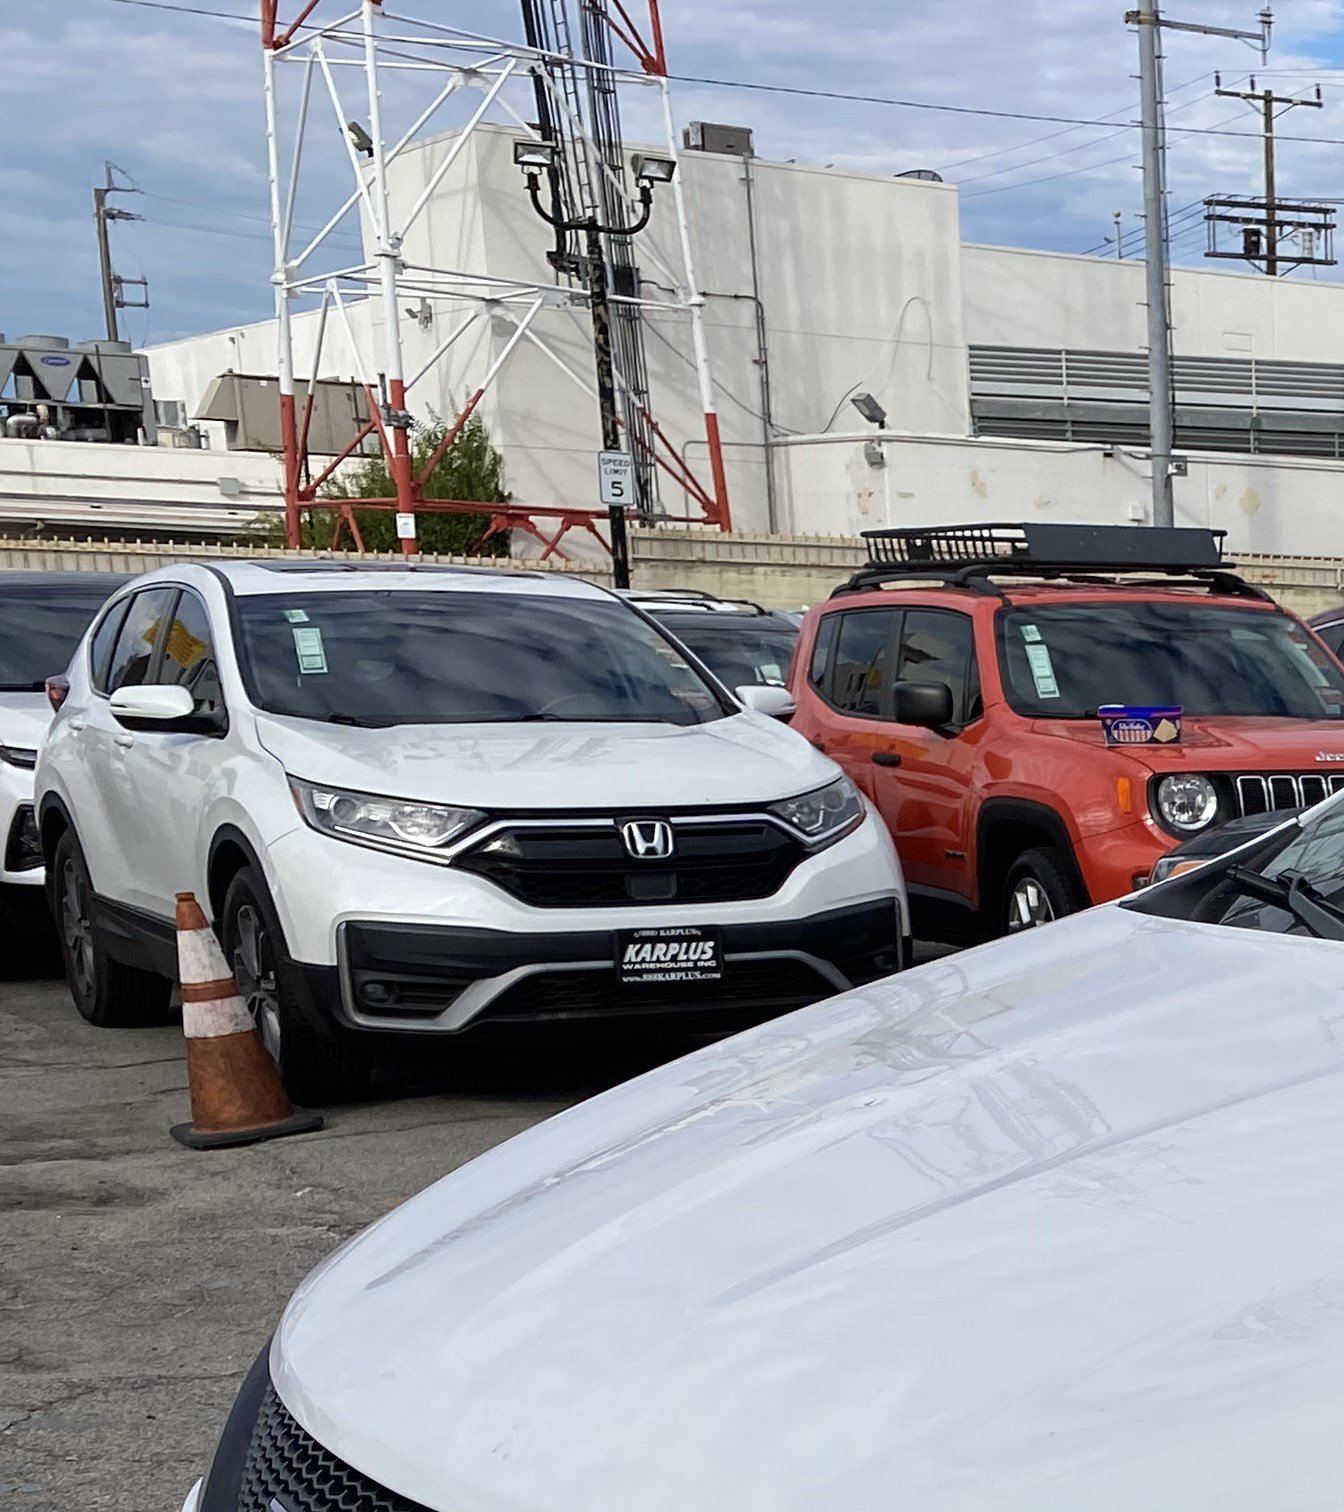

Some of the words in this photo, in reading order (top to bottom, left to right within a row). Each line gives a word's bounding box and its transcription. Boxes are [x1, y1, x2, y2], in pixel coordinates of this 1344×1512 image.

[602, 458, 630, 467] SPEED
[604, 467, 628, 476] LIMIT
[611, 480, 624, 497] 5
[623, 941, 715, 963] KARPLUS
[622, 962, 694, 970] WAREHOUSE
